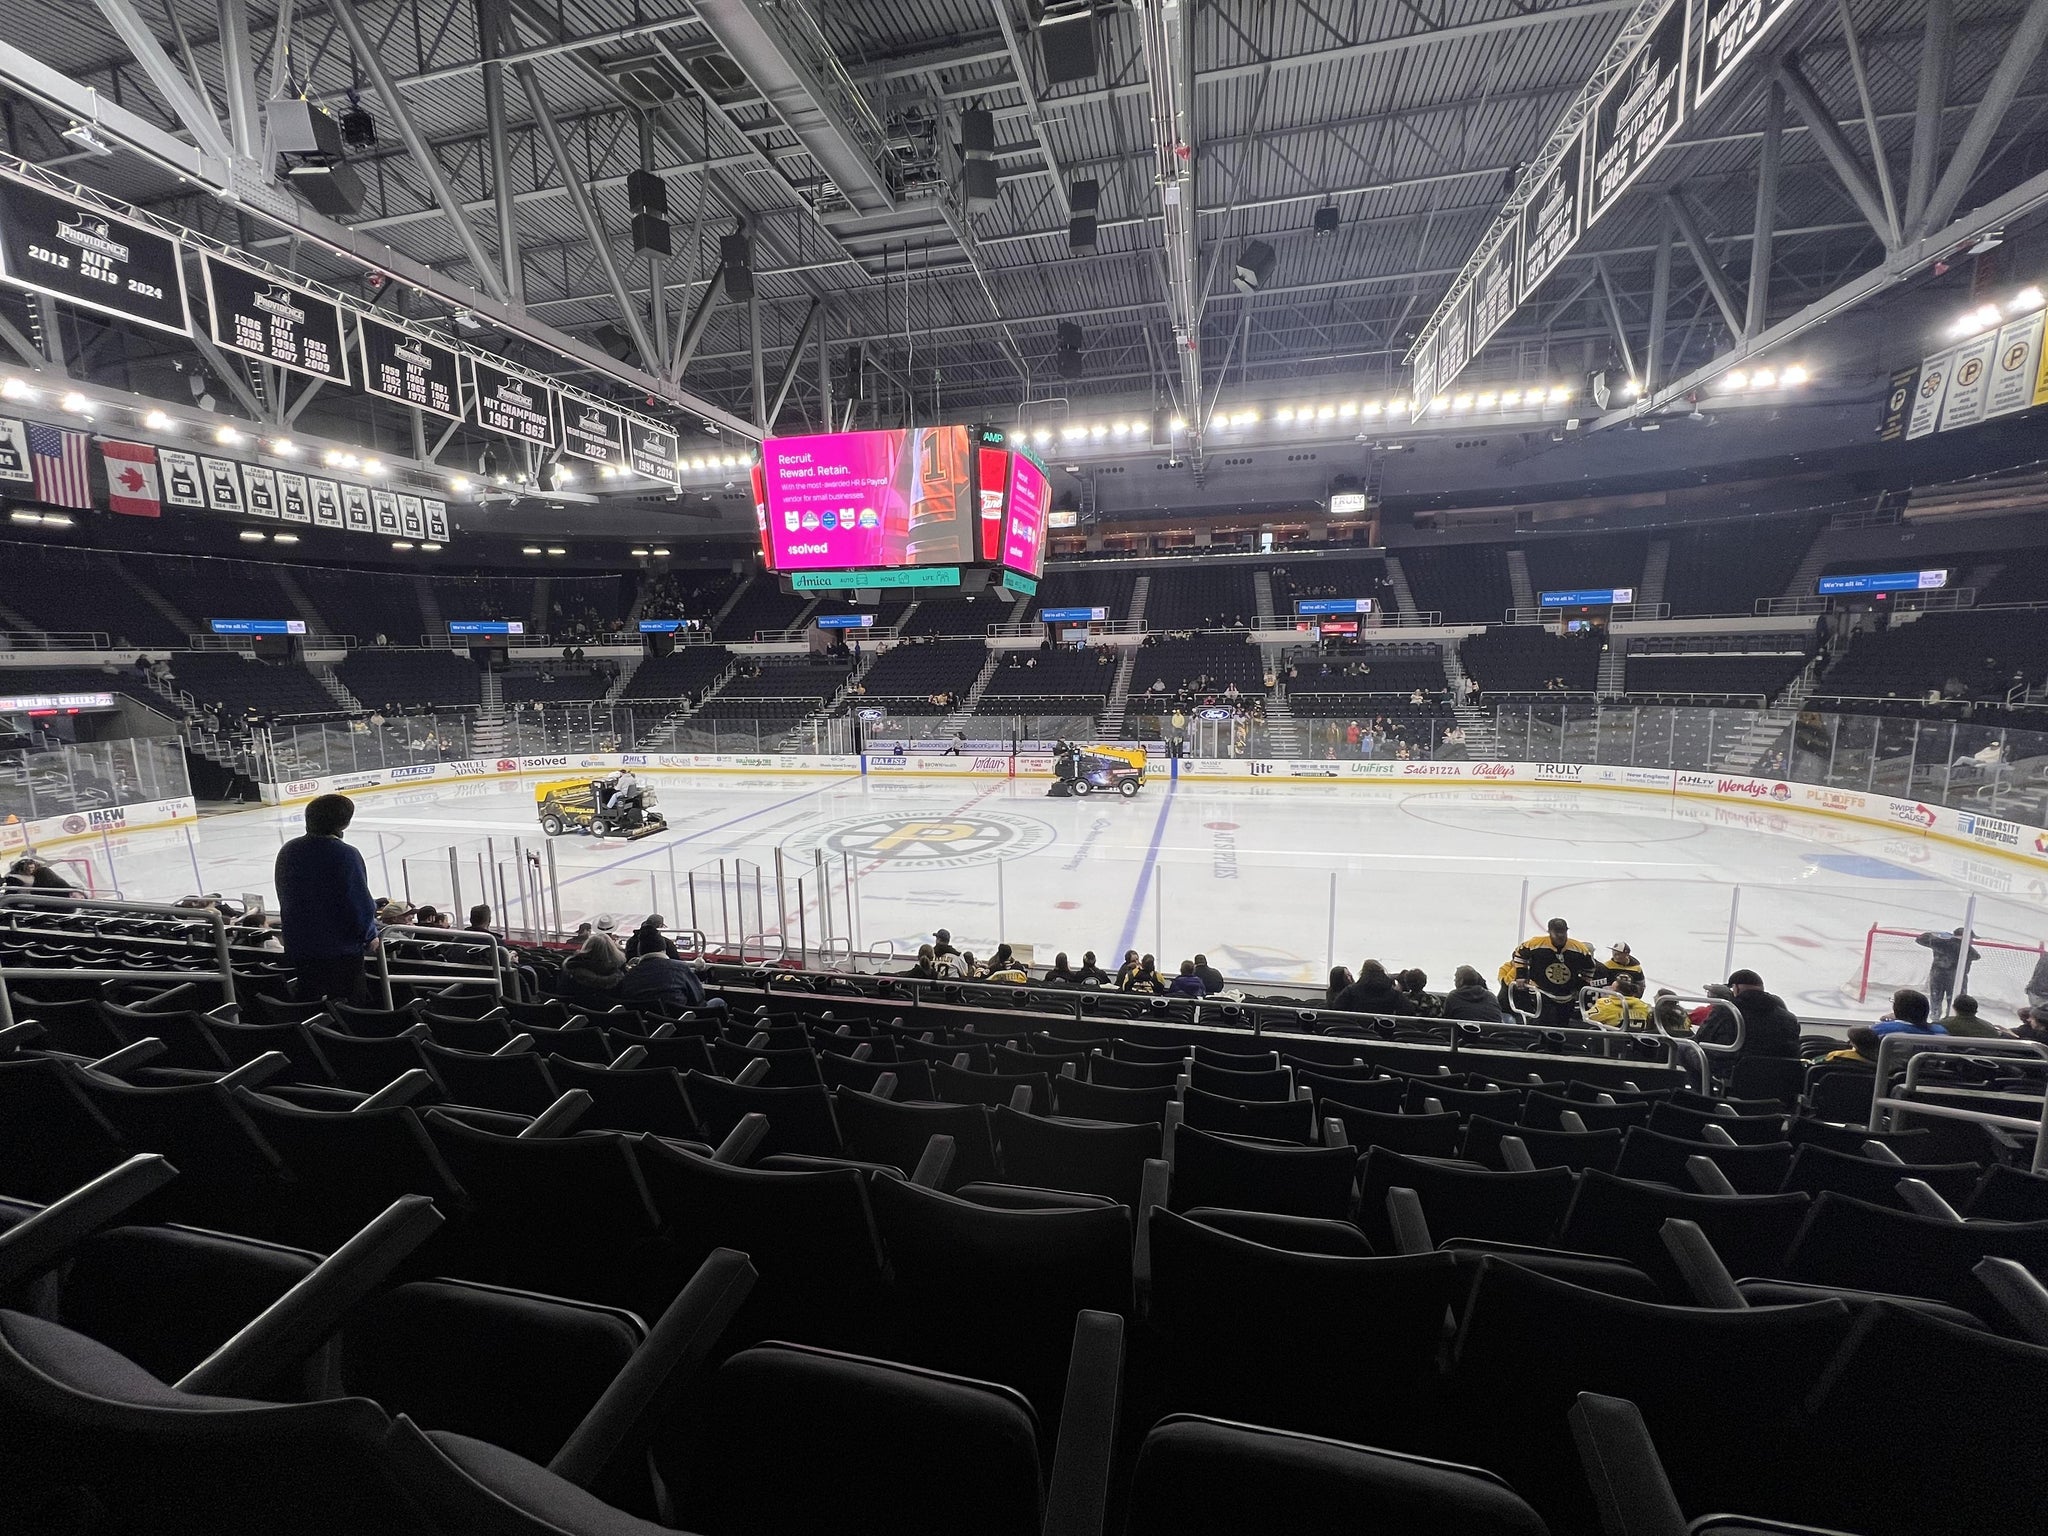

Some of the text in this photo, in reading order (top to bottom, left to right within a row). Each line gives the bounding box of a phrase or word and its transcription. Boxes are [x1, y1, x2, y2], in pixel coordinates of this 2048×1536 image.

[1618, 104, 1647, 153] ELITE
[1646, 63, 1679, 120] EIGHT
[1599, 100, 1669, 203] 1965 1997
[60, 222, 127, 257] PROVIDENCE
[81, 249, 113, 270] NIT
[28, 245, 163, 299] 2013 2019 2024
[271, 314, 293, 331] NIT
[234, 313, 327, 353] 1986 1991 1993
[236, 324, 328, 363] 1995 1996 1999
[236, 336, 330, 373] 2003 2007 2009
[406, 363, 423, 376] NIT
[483, 396, 499, 411] NIT
[500, 402, 547, 426] CHAMPIONS
[489, 411, 514, 430] 1961
[520, 421, 545, 439] 1963
[982, 432, 1004, 443] AMP
[585, 442, 607, 459] 2022
[778, 453, 814, 464] Recruit.
[657, 466, 673, 479] 2014
[780, 465, 851, 478] Reward. Retain.
[781, 483, 794, 491] With
[795, 482, 806, 490] the
[851, 479, 860, 487] HR
[861, 479, 867, 487] &
[867, 477, 888, 487] Payroll
[218, 490, 231, 500] 24
[803, 494, 812, 502] for
[1333, 496, 1364, 505] TRULY
[288, 501, 300, 511] 24
[796, 574, 832, 588] Amica
[16, 698, 57, 707] BUILDING
[864, 710, 881, 719] Ford
[1206, 709, 1224, 718] Ford
[450, 760, 487, 770] SAMUEL
[872, 757, 907, 765] BALISE
[970, 757, 1005, 772] Jordan's
[1351, 762, 1395, 773] UniFirst
[392, 766, 434, 777] BALISE
[455, 767, 485, 777] ADAMS
[1250, 761, 1274, 777] Lite
[1403, 765, 1461, 775] Sal's PIZZA
[1472, 763, 1515, 776] Bally's
[1535, 763, 1583, 775] TRULY
[288, 781, 316, 793] RE-BATH
[1717, 779, 1768, 797] Wendy's
[158, 803, 189, 813] ULTRA
[1889, 802, 1915, 814] SWIPE
[88, 808, 125, 825] IBEW
[1898, 811, 1925, 824] CAUSE
[1976, 816, 2020, 835] UNIVERSITY
[1974, 827, 2018, 845] ORTHOPEDICS
